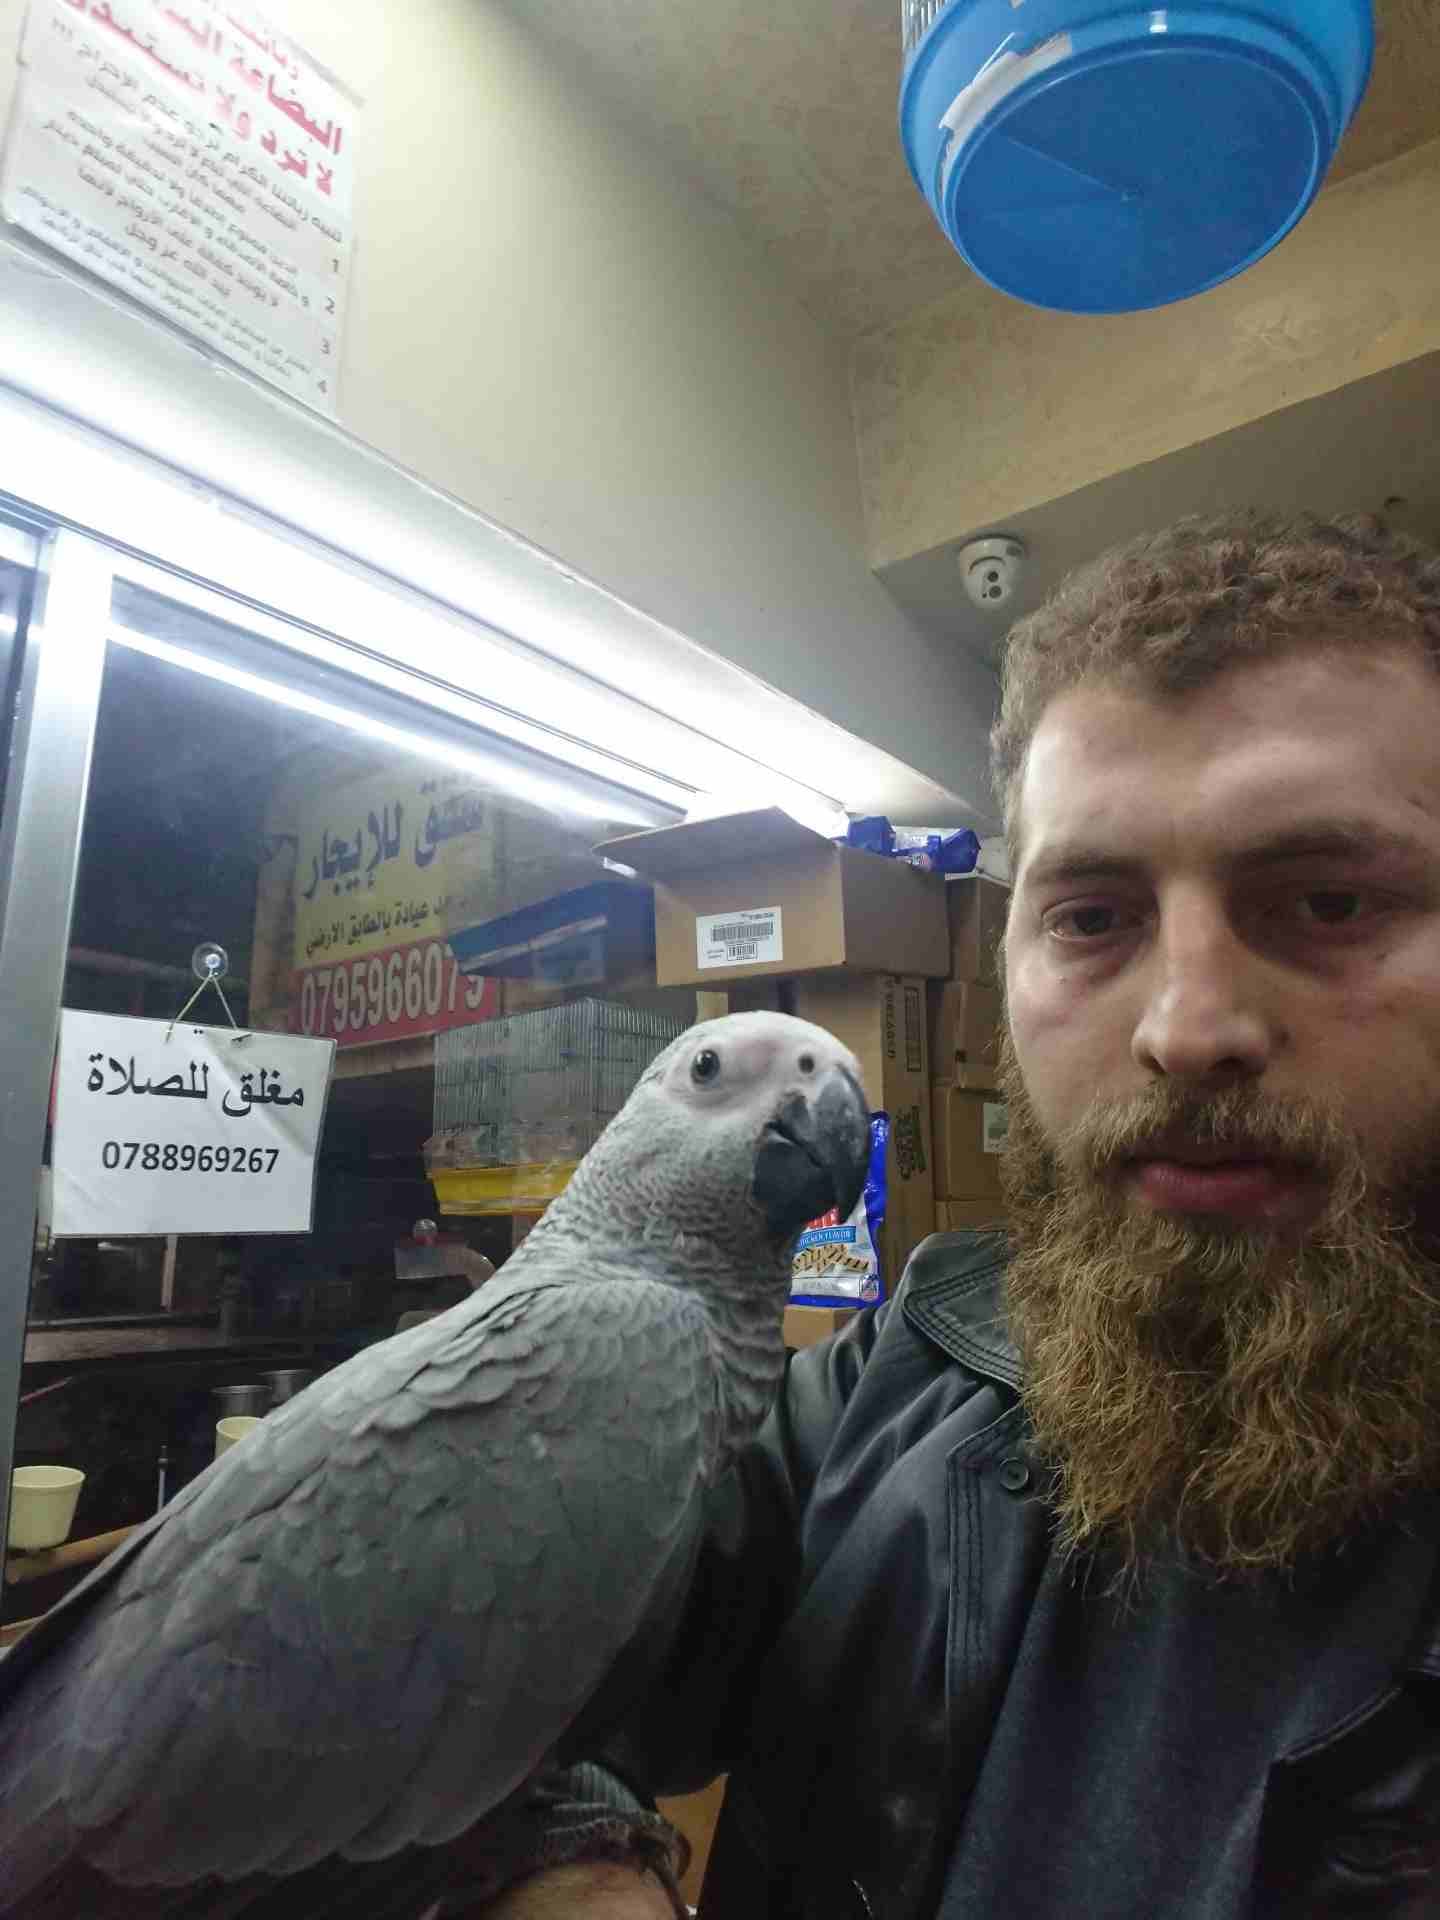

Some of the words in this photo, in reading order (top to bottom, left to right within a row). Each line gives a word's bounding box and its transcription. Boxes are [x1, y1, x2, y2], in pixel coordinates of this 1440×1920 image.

[228, 40, 342, 157] البضاعة
[87, 1052, 209, 1099] للصلاة
[222, 1068, 304, 1117] مغلق
[102, 1141, 280, 1174] 0788969267
